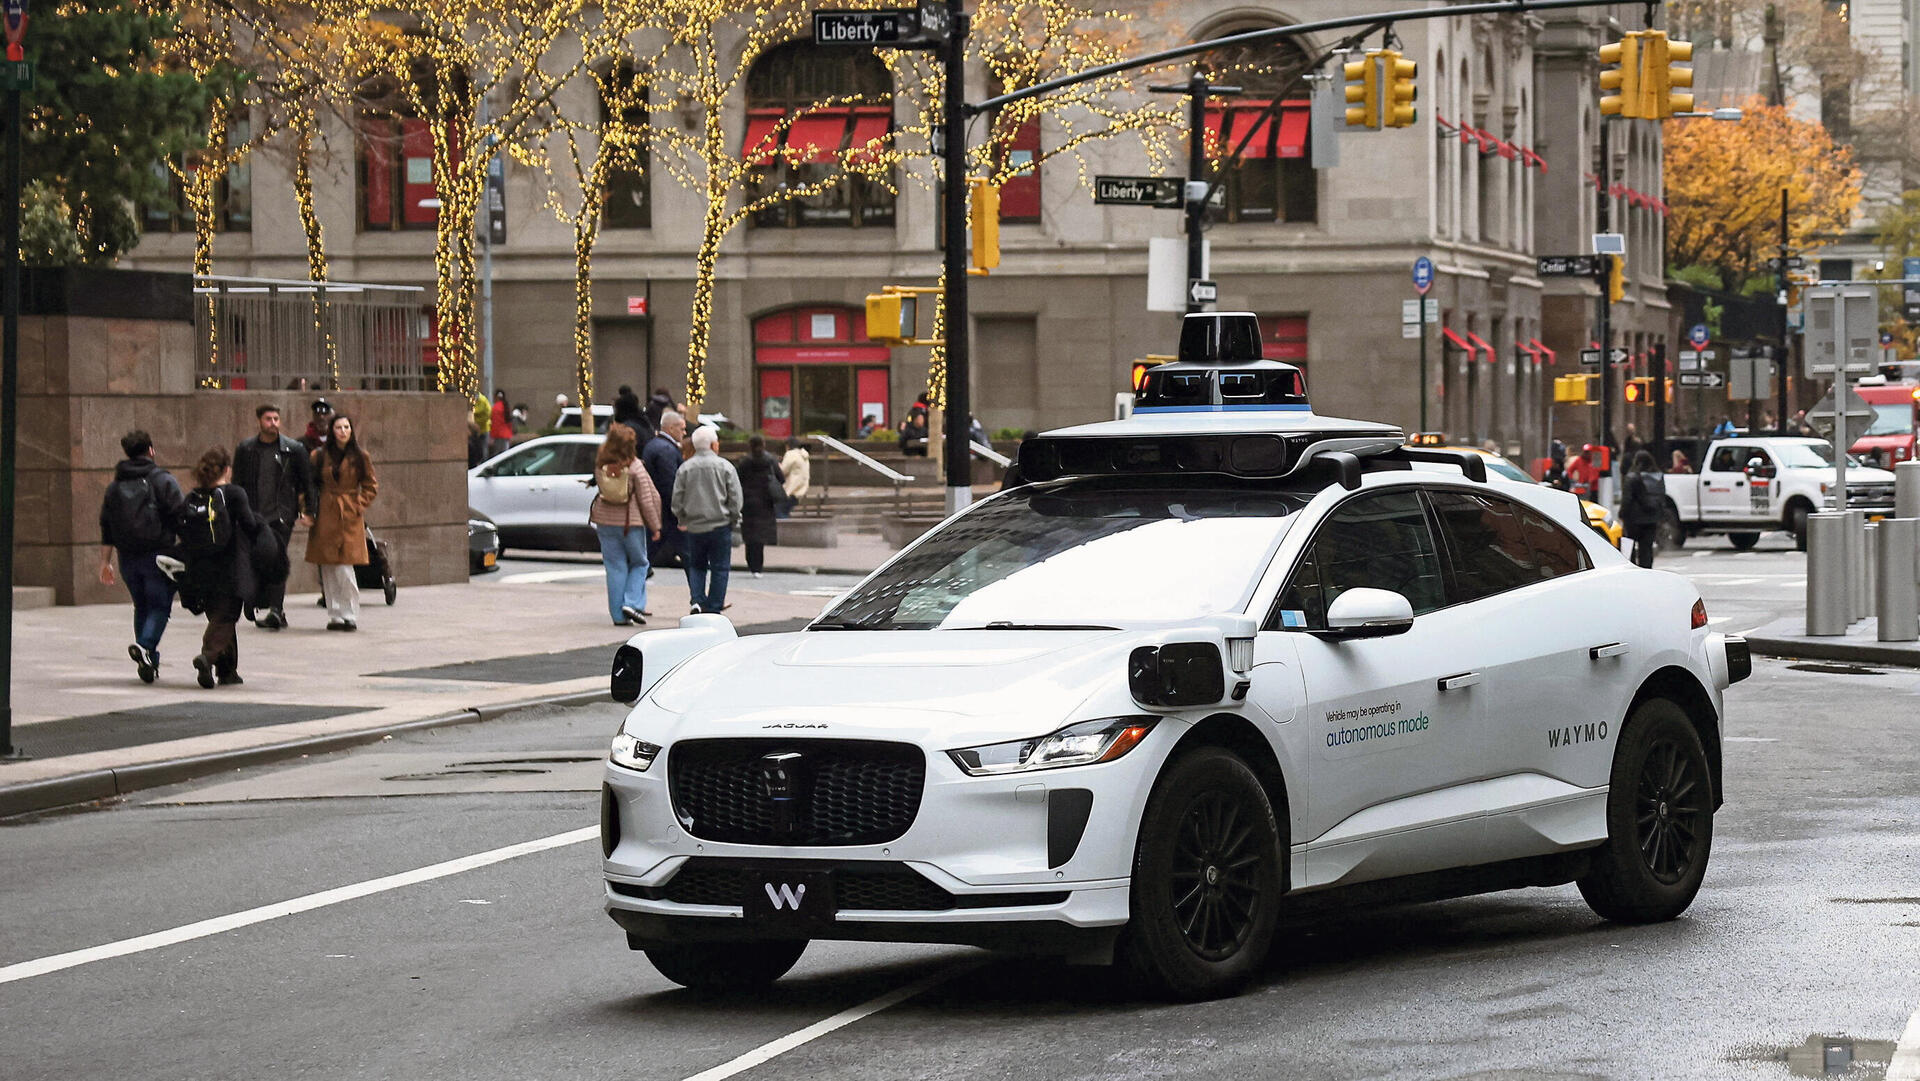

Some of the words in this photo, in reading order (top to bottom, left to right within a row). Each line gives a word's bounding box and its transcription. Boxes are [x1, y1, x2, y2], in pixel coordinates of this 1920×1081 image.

[821, 20, 880, 42] Liberty
[1101, 183, 1144, 201] Liberty
[1325, 709, 1346, 722] Vehicle
[1346, 710, 1359, 720] may
[1359, 706, 1368, 717] be
[1368, 702, 1395, 717] operating
[1395, 700, 1402, 710] in
[1326, 721, 1396, 747] autonomous
[1398, 710, 1429, 734] mode
[1548, 720, 1608, 748] WAYMO
